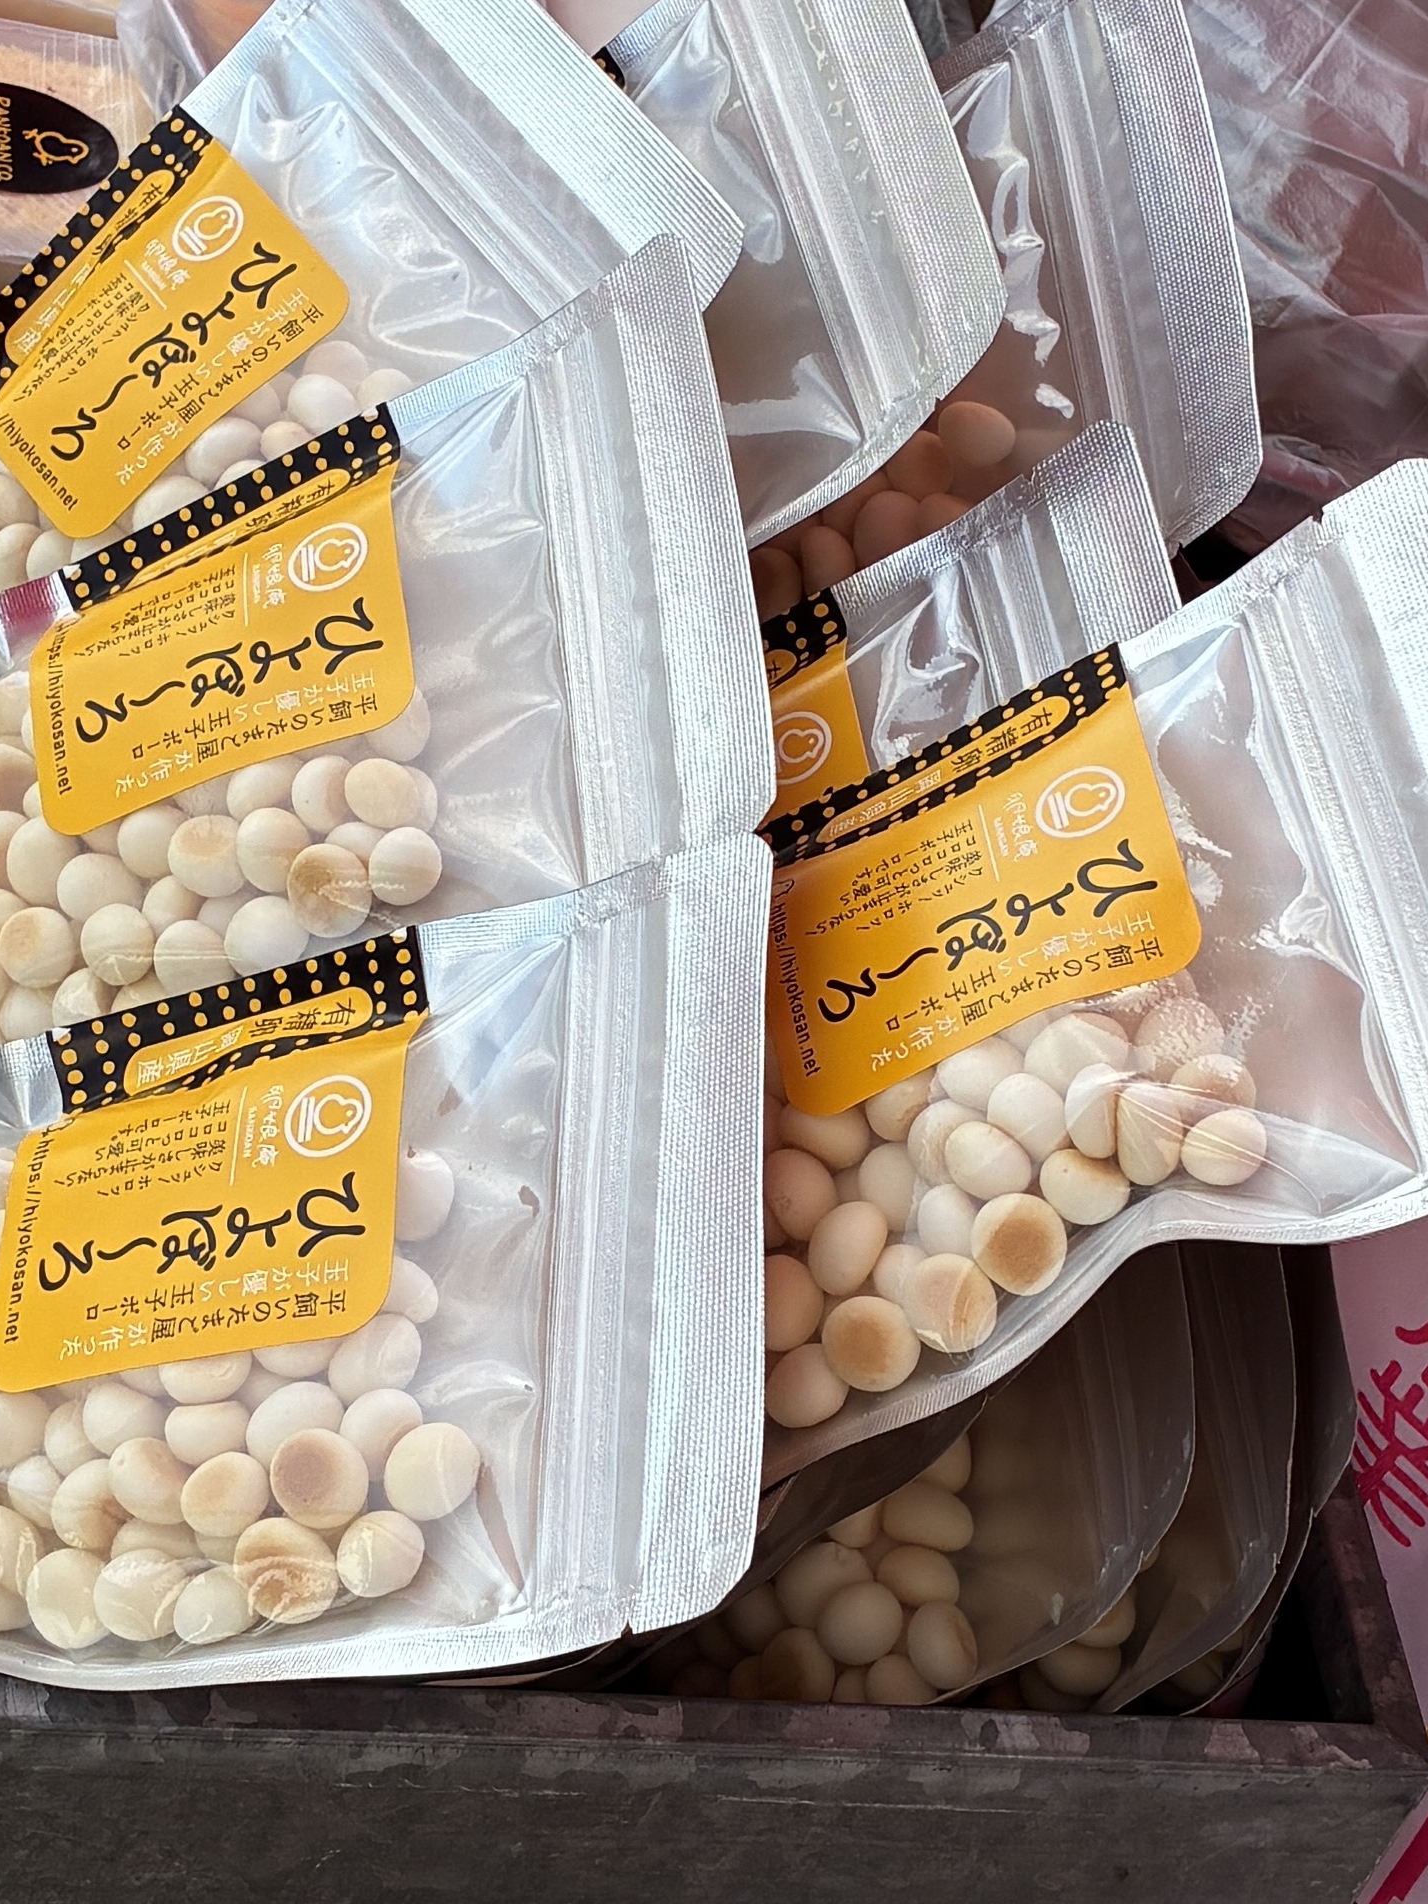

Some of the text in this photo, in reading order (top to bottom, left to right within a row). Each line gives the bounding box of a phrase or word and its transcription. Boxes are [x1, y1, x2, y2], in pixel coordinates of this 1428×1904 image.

[252, 996, 357, 1040] 有精卵
[871, 939, 1164, 1070] 平飼いのたまご屋が作った
[885, 914, 1156, 1031] 玉子が優しい玉子ボーロ
[3, 1136, 53, 1344] https://hiyokosan.net
[58, 1289, 347, 1360] 平飼いのたまご屋が作った
[86, 1258, 350, 1321] 玉子が優しい玉子ボーロ
